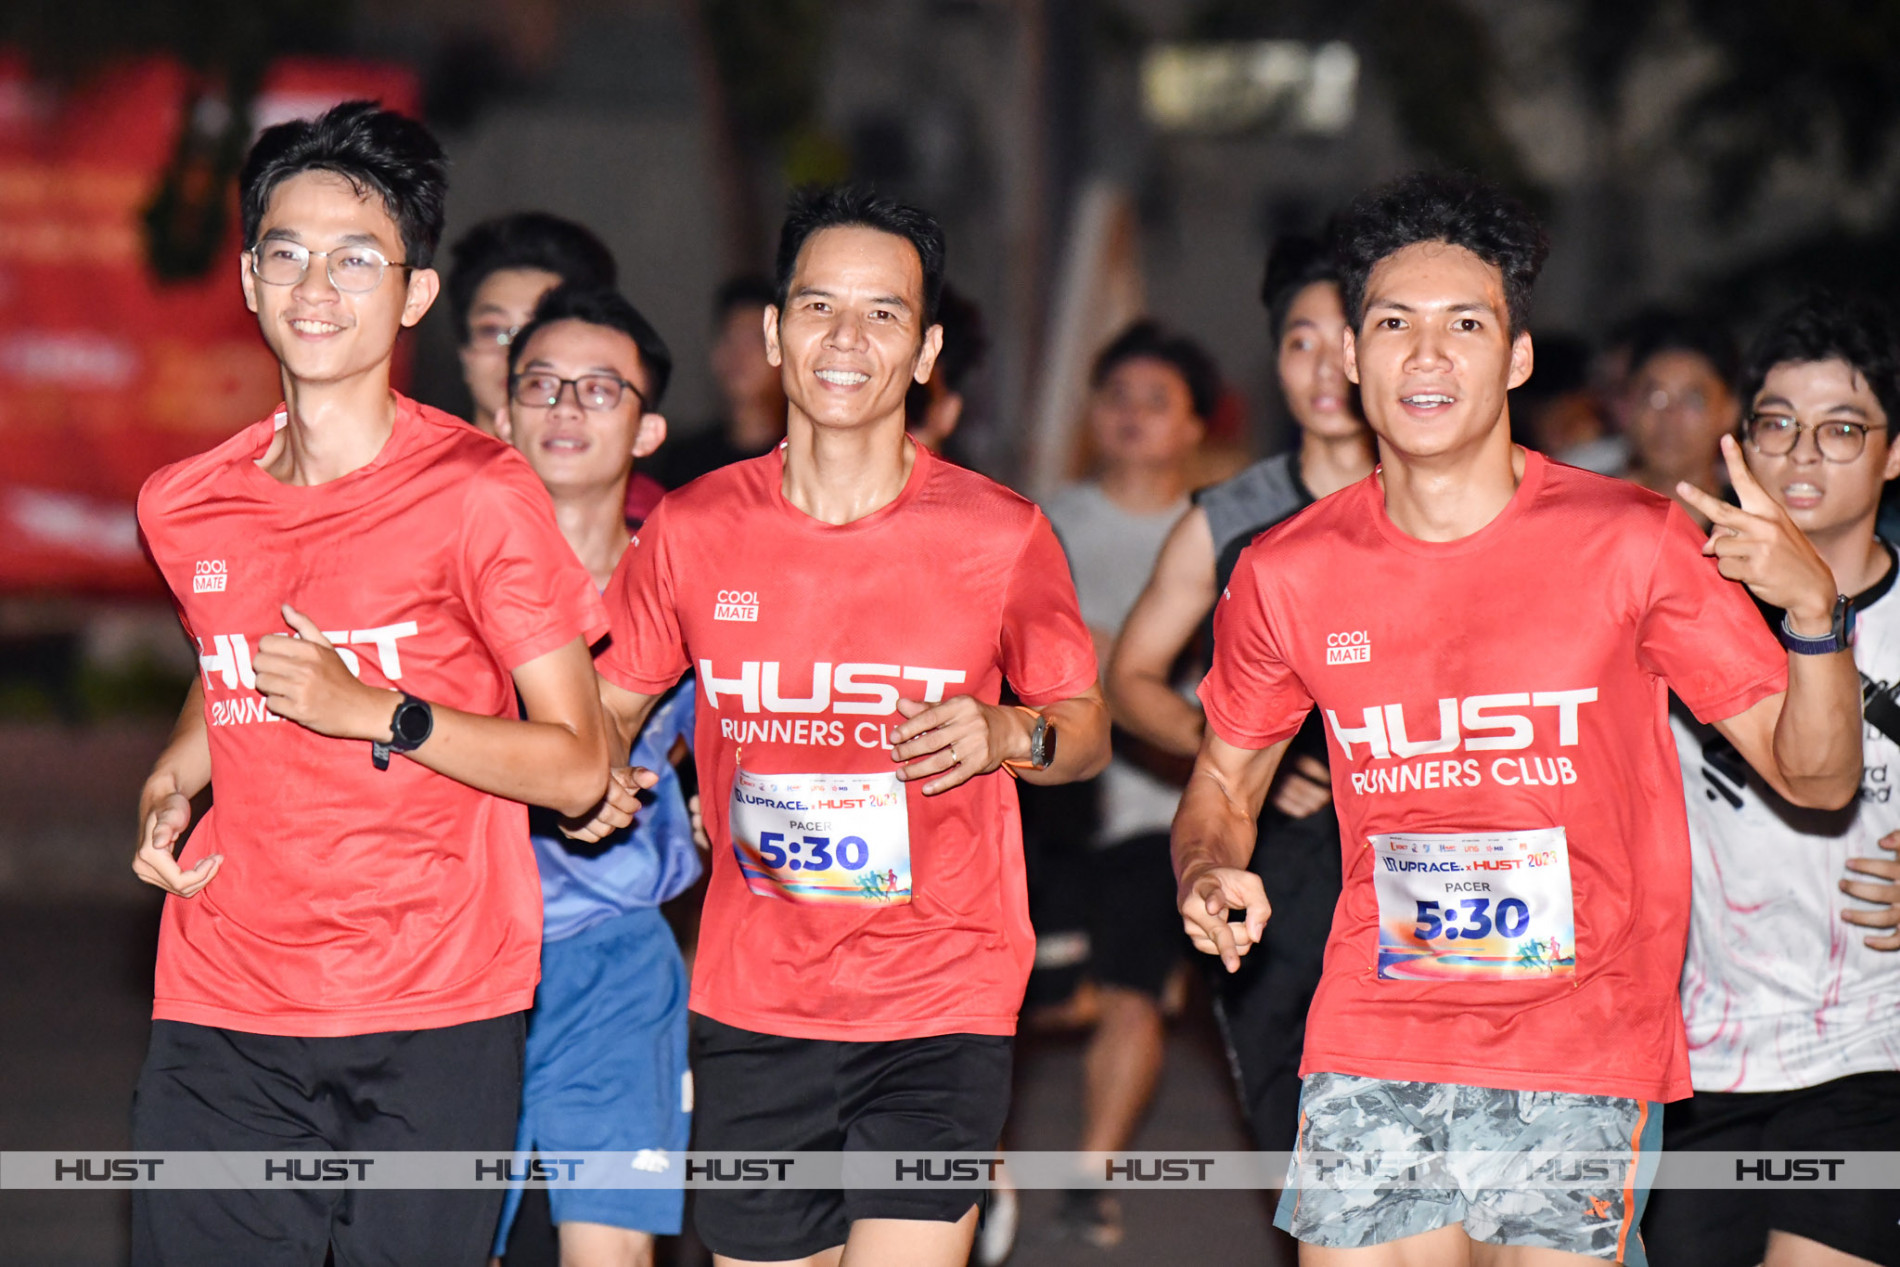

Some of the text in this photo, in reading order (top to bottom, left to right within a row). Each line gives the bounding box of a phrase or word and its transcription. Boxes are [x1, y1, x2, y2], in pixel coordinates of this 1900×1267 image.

[195, 575, 225, 591] MATE
[717, 590, 759, 605] COOL
[717, 605, 755, 620] MATE
[1327, 630, 1370, 647] COOL
[1329, 647, 1367, 663] MATE
[699, 659, 966, 716] HUST
[212, 697, 287, 727] RUNN
[1326, 687, 1598, 761] HUST
[721, 718, 897, 750] RUNNERS CL
[1352, 756, 1578, 795] RUNNERS CLUB
[818, 799, 866, 809] HUST
[789, 820, 832, 832] PACER
[759, 831, 869, 872] 5:30
[1473, 859, 1524, 871] HUST
[1527, 850, 1558, 868] 2023
[1445, 882, 1491, 893] PACER
[1414, 898, 1530, 941] 5:30
